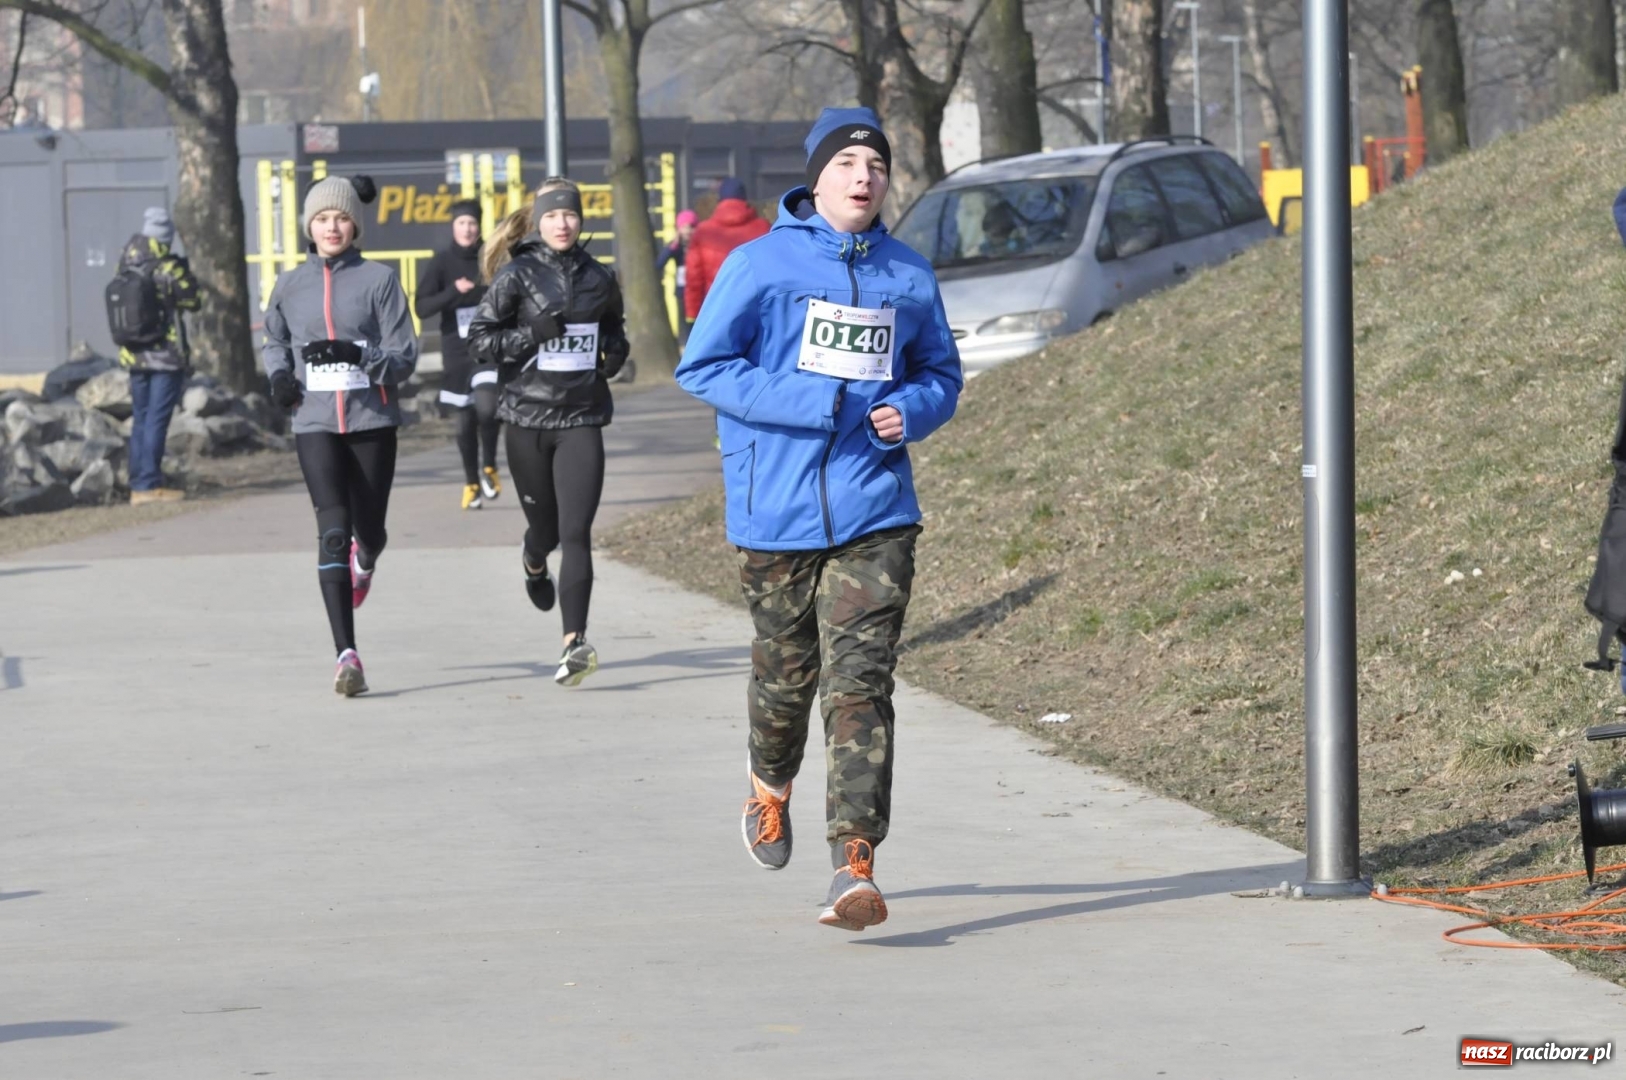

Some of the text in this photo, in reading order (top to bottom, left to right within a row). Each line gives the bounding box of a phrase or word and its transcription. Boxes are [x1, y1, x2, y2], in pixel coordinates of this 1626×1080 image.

[377, 184, 464, 225] Plaż
[546, 335, 593, 353] 0124
[815, 321, 888, 353] 0140
